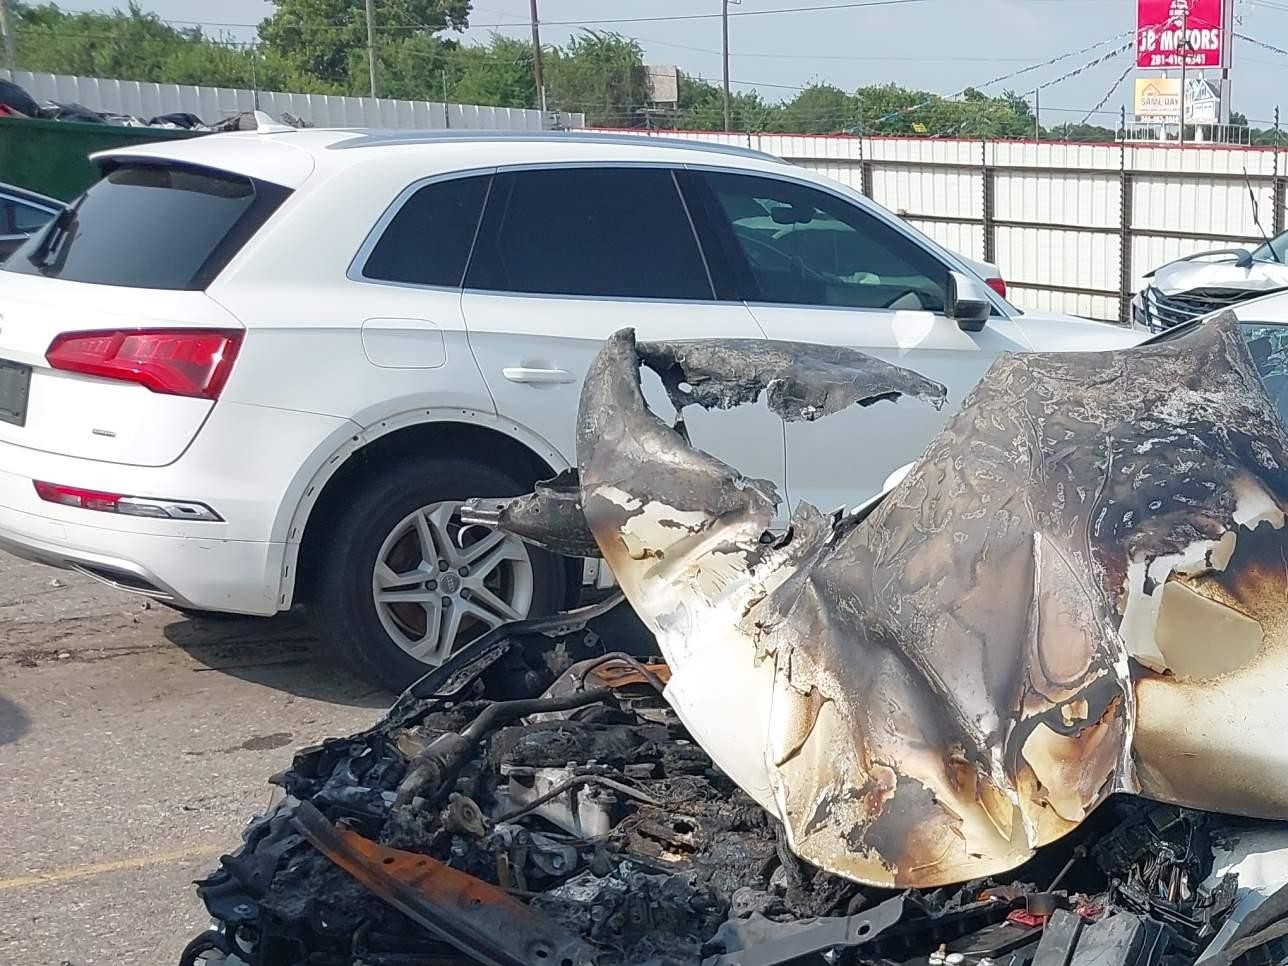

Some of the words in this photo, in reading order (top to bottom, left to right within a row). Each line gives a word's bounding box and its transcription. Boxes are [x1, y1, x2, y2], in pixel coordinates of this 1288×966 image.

[1160, 28, 1219, 52] MOTORS
[1141, 97, 1162, 106] SAME
[1164, 97, 1179, 106] DAY
